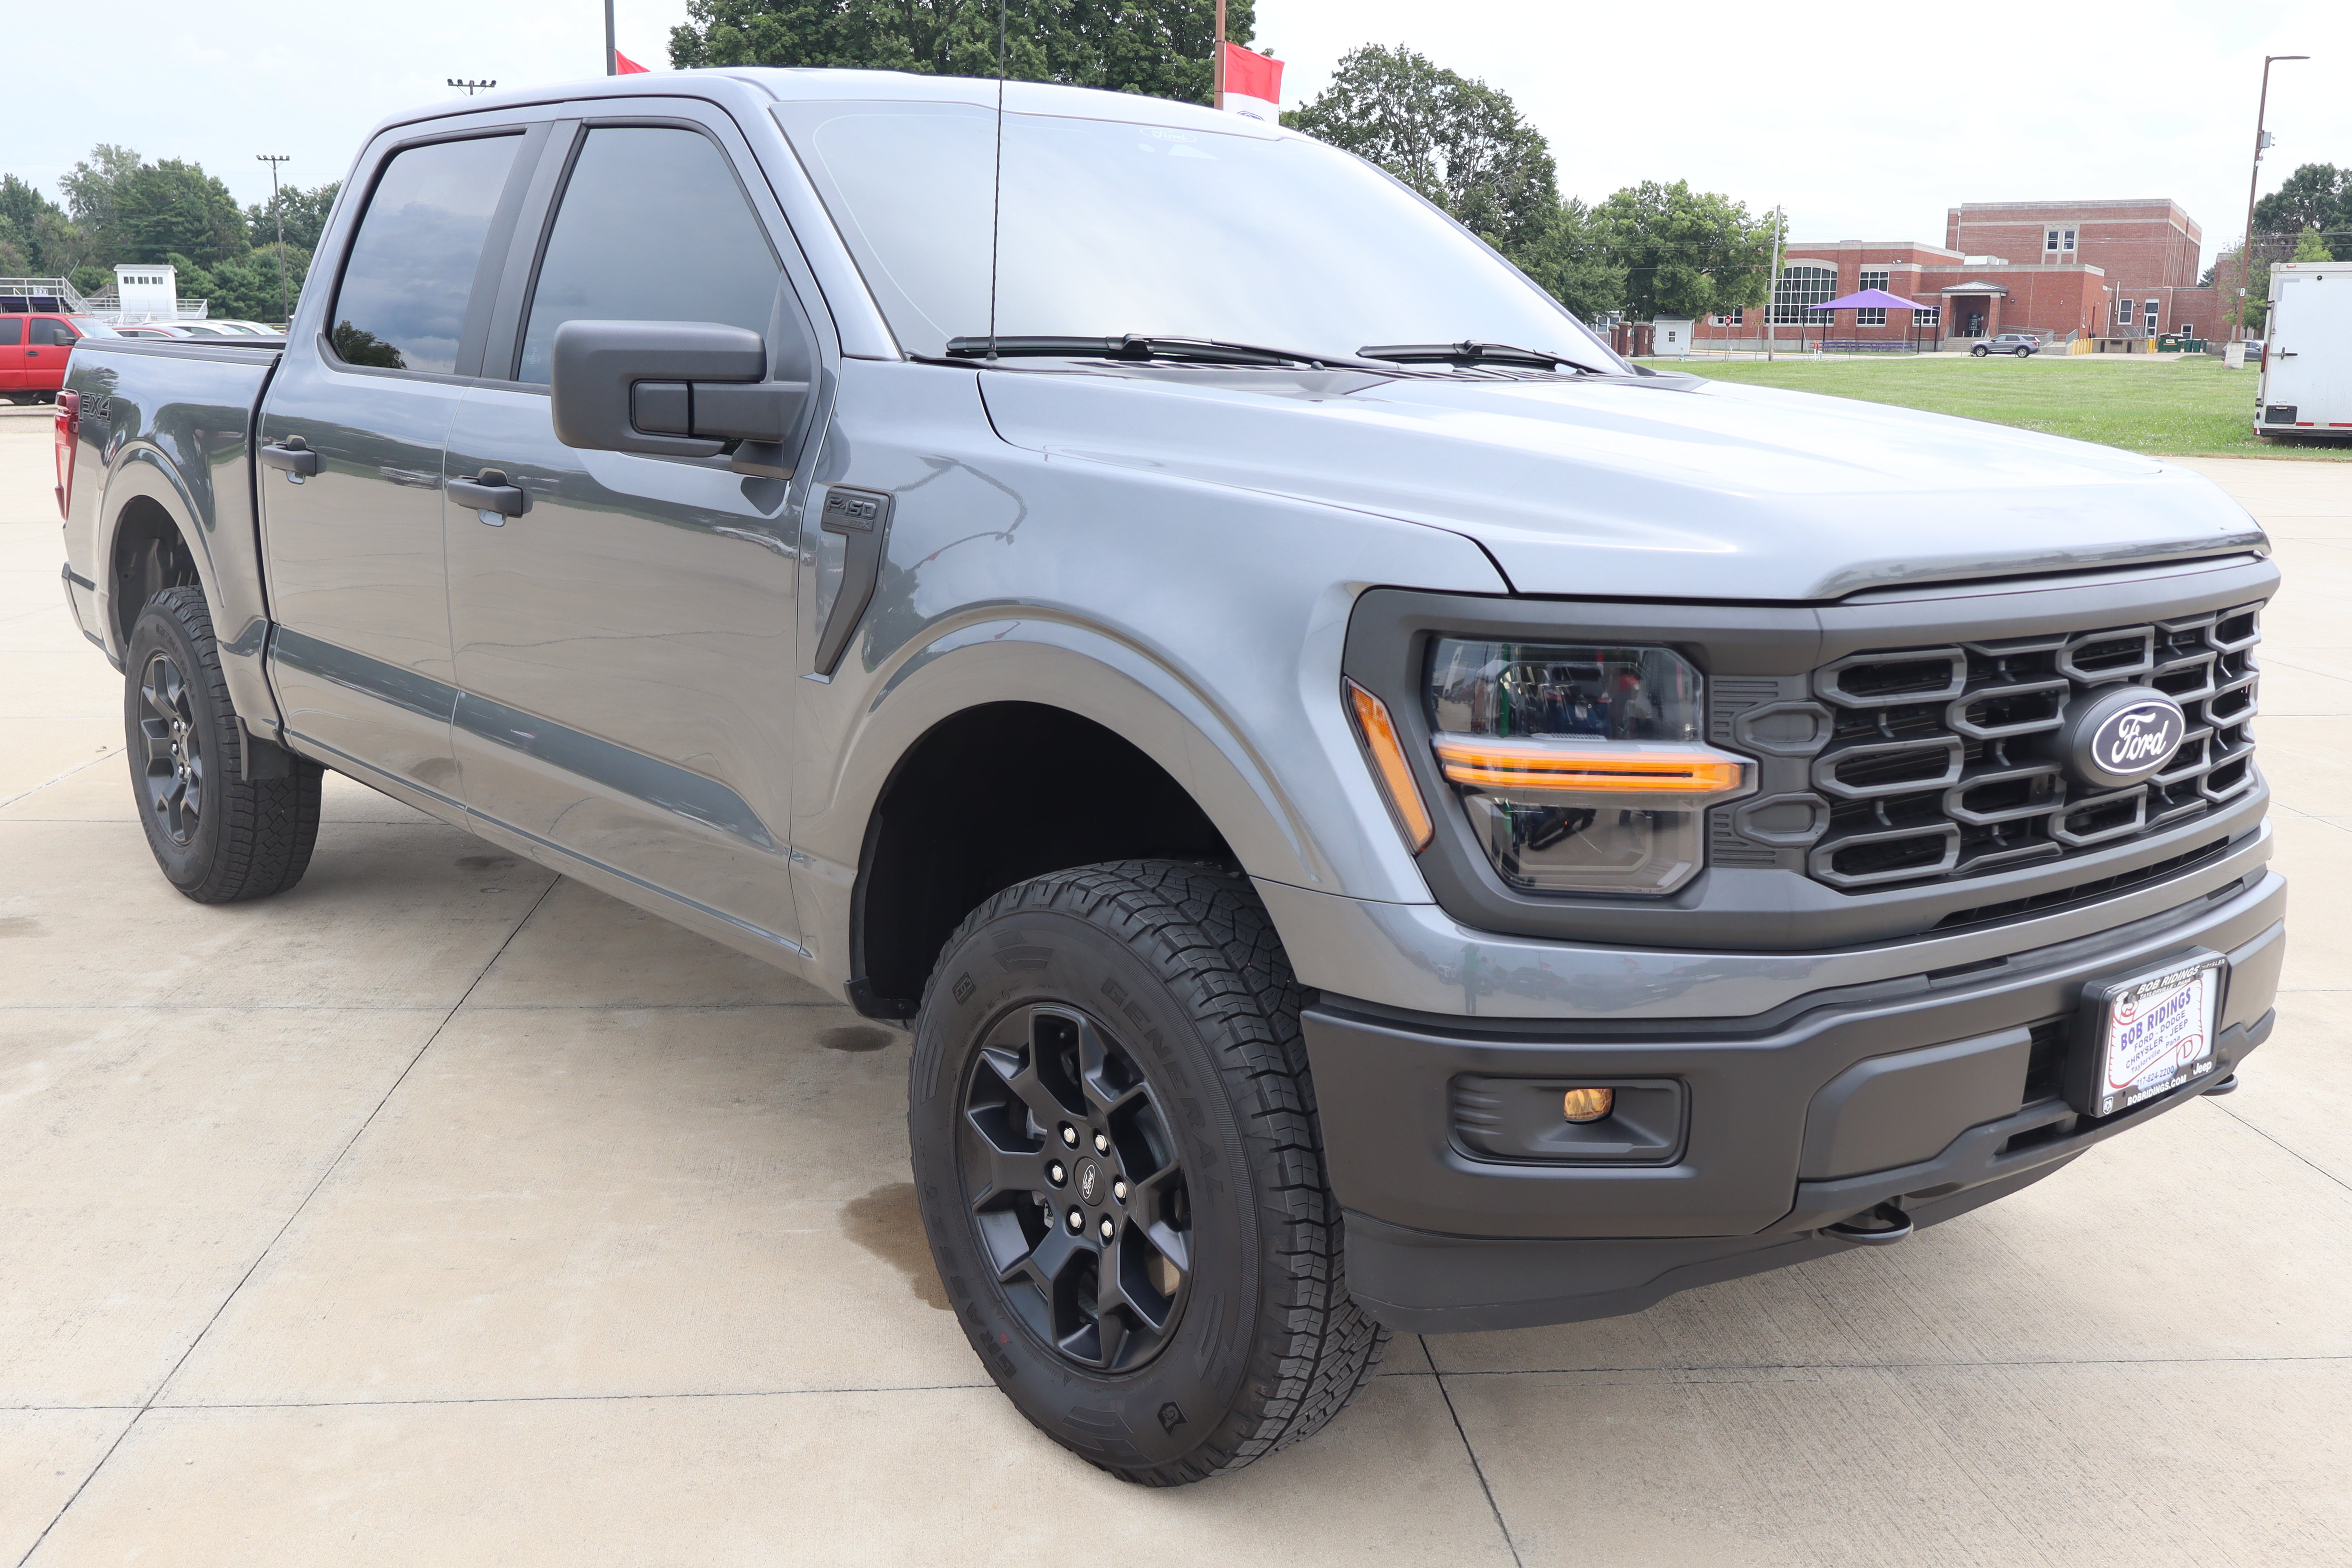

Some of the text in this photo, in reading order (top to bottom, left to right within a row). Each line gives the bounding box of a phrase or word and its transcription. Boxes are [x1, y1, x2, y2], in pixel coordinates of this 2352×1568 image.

[1152, 129, 1188, 140] Ford
[79, 392, 113, 423] FX4
[826, 497, 877, 519] F-150
[849, 519, 871, 529] STX
[2111, 712, 2169, 763] Ford
[2136, 965, 2200, 994] BOB RIDINGS
[2140, 984, 2174, 999] TAYLORVILLE
[2177, 978, 2191, 986] PANA
[2121, 987, 2191, 1051] BOB RIDINGS
[2134, 1032, 2154, 1051] FORD
[2160, 1009, 2185, 1032] DODGE
[2126, 1036, 2163, 1069] CHRYSLER
[2170, 1018, 2188, 1036] JEEP
[2131, 1036, 2180, 1074] Taylorville Pana
[2136, 1065, 2174, 1087] 217-824-2200
[2193, 1061, 2212, 1075] Jeep
[1100, 977, 1223, 1207] GENERAL
[2127, 1074, 2187, 1106] BOBRIDINGS.COM
[1084, 1170, 1094, 1194] Ford
